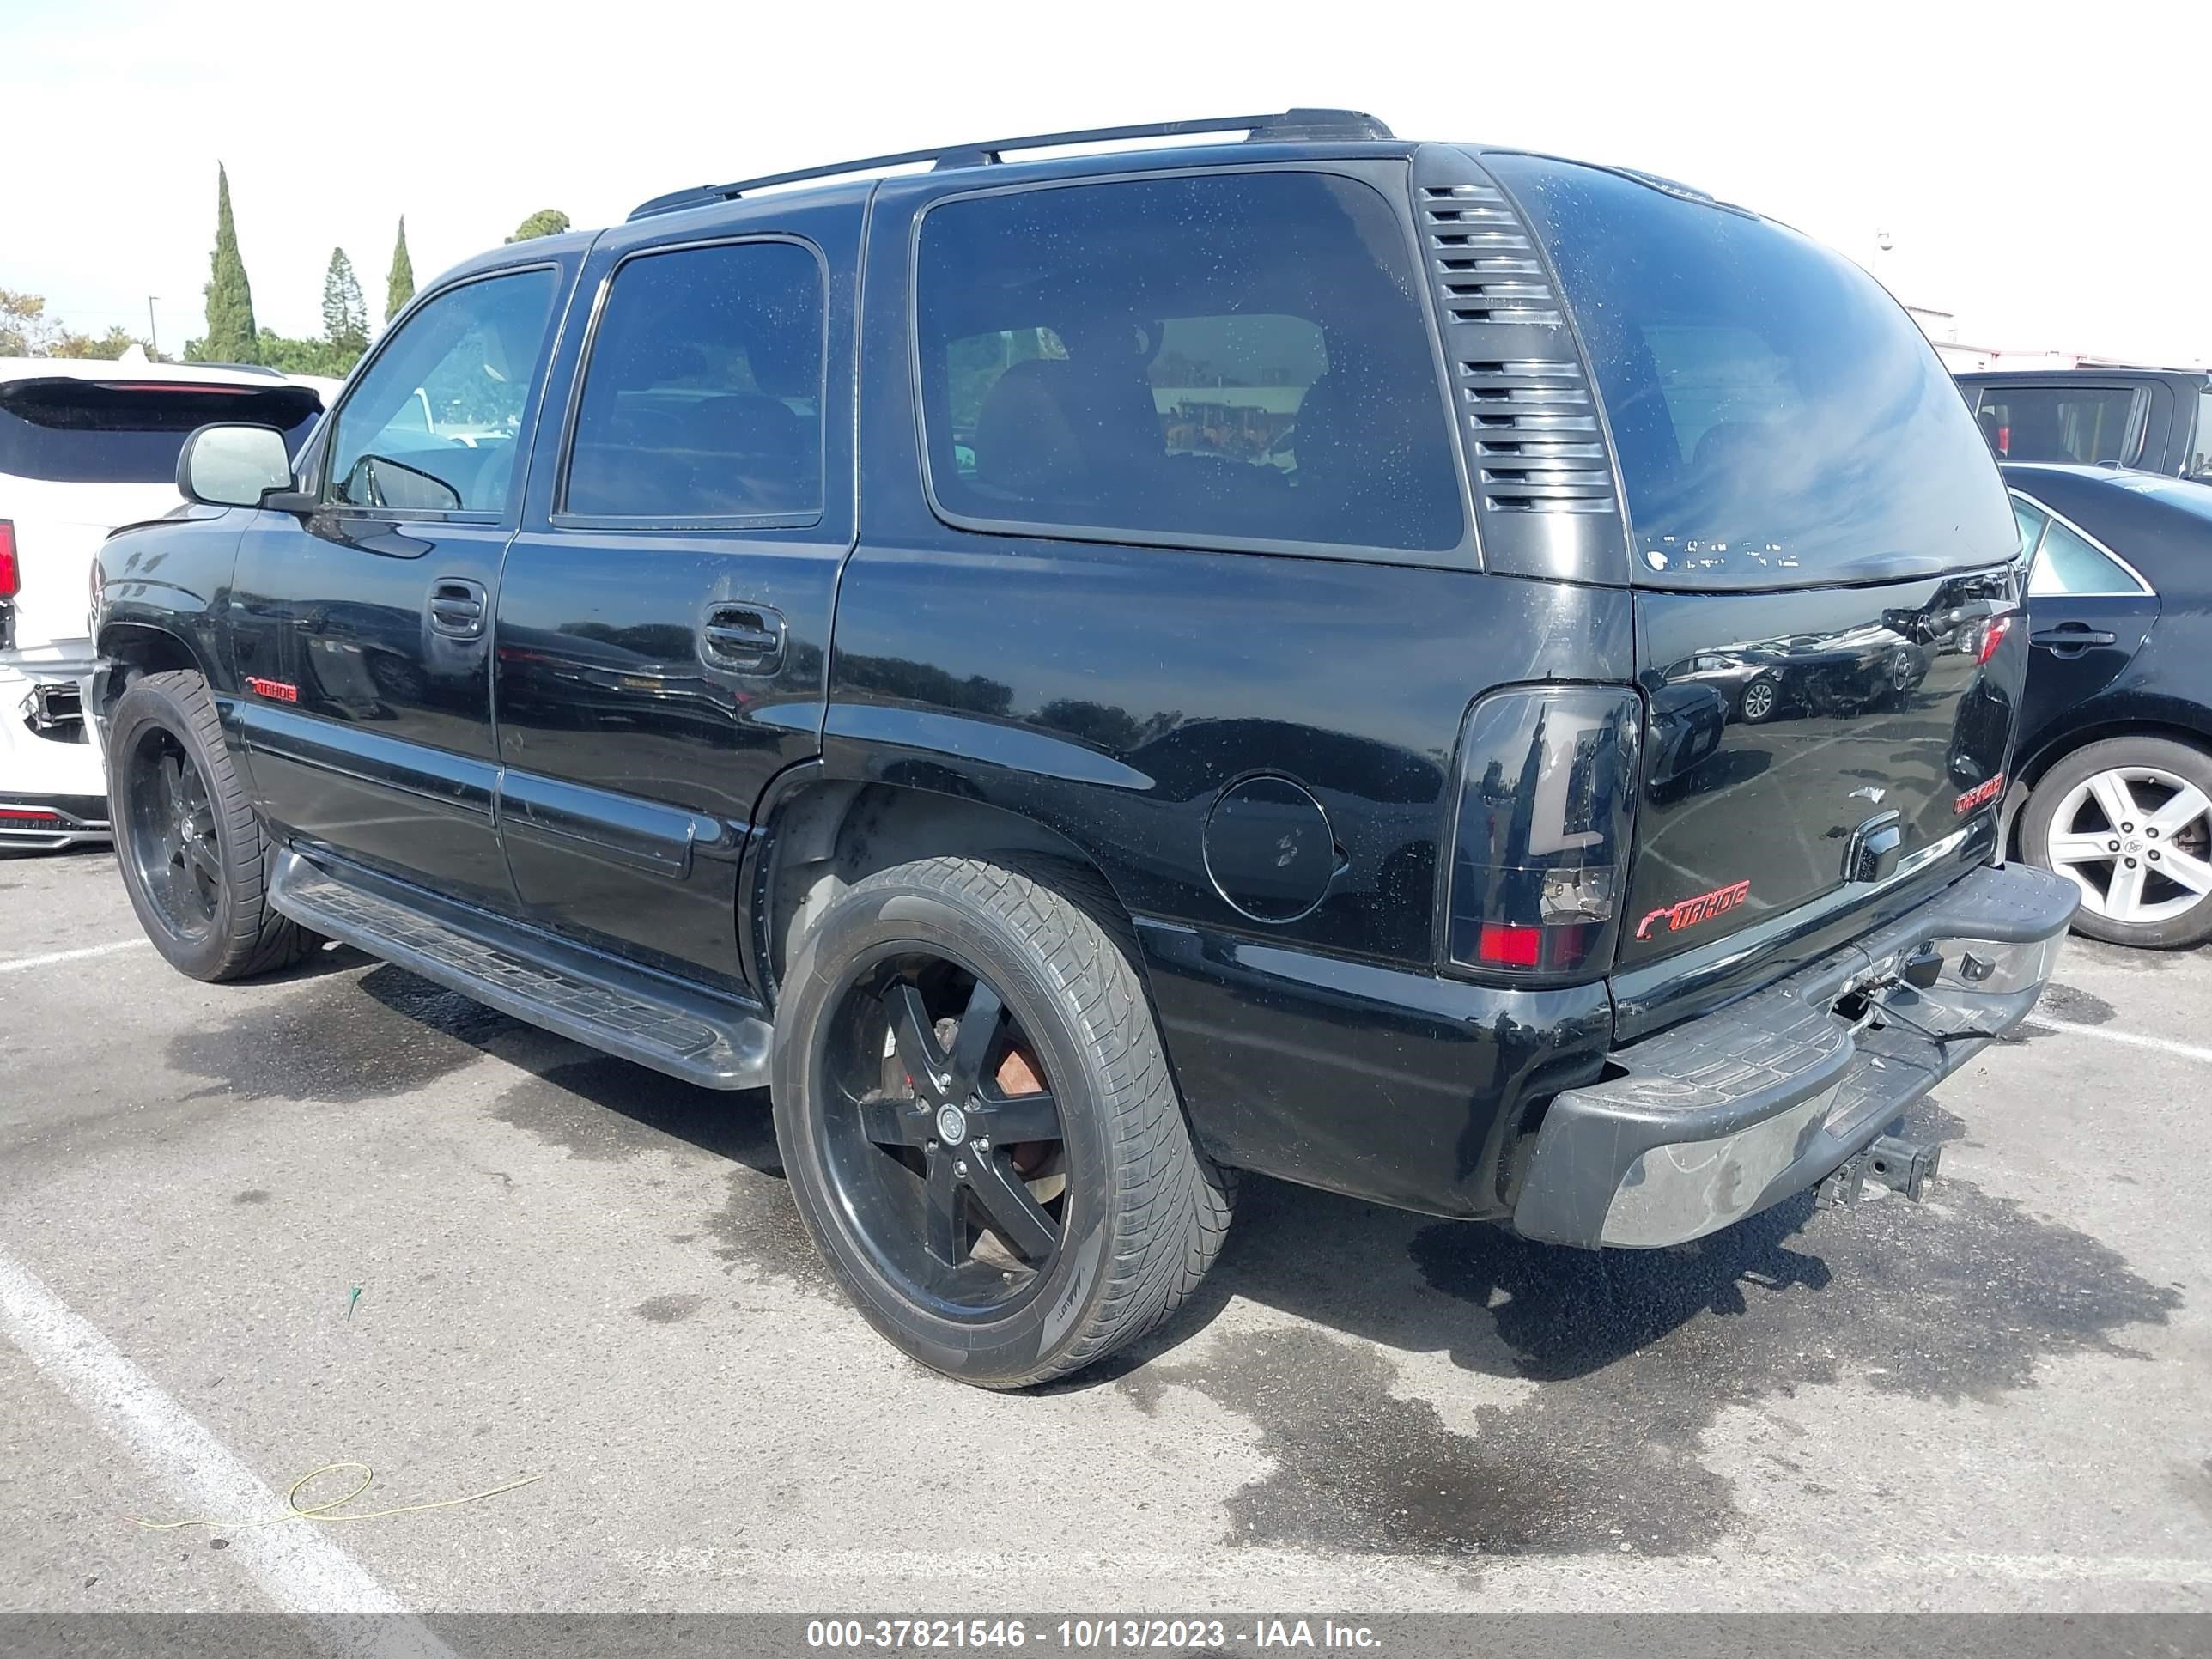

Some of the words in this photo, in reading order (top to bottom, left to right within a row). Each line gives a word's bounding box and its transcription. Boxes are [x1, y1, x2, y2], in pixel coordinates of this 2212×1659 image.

[258, 681, 296, 702] TAHOE
[1670, 882, 1750, 930] TAHOE
[959, 918, 1041, 1002] TOYO
